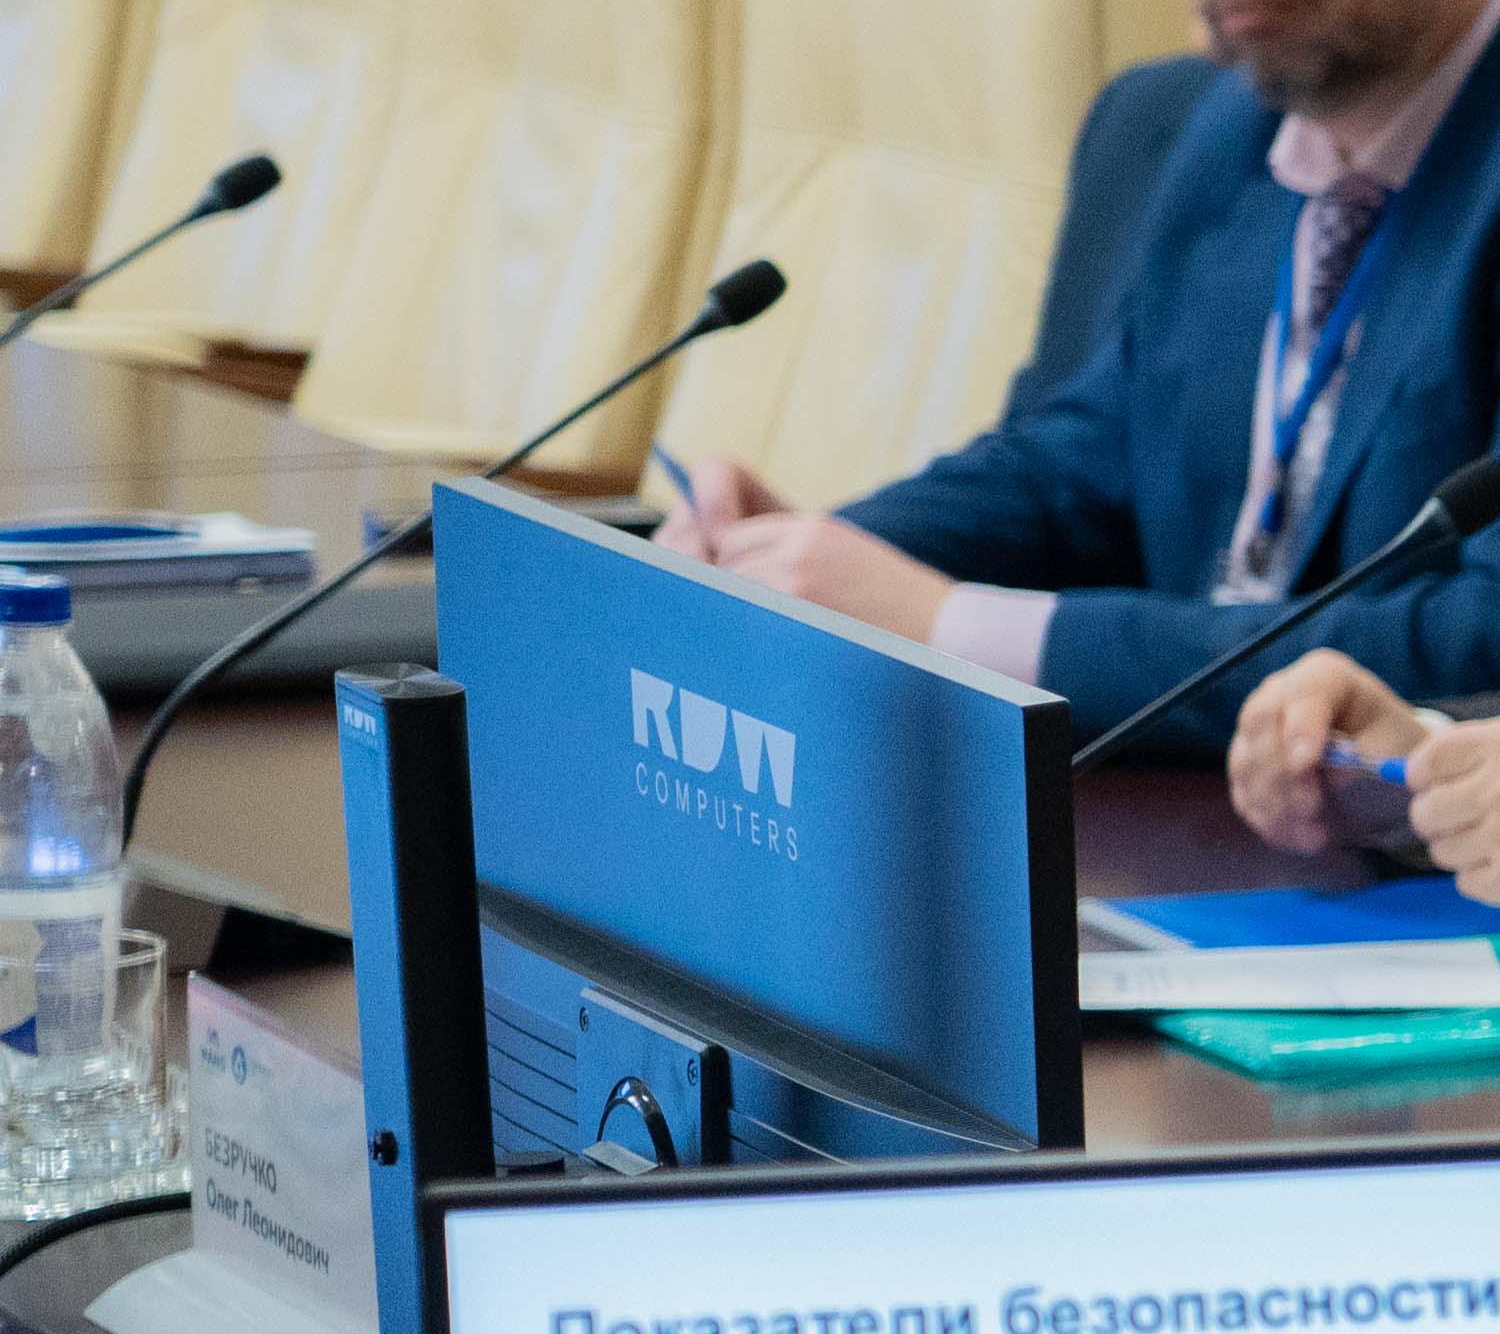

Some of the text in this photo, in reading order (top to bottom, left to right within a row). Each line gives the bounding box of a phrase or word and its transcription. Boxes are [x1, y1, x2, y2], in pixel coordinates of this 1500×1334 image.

[631, 667, 796, 808] RDW
[635, 762, 798, 861] COMPUTERS
[205, 1128, 277, 1195] БЕЗРУЧКО
[206, 1177, 330, 1274] Олег Леонидович
